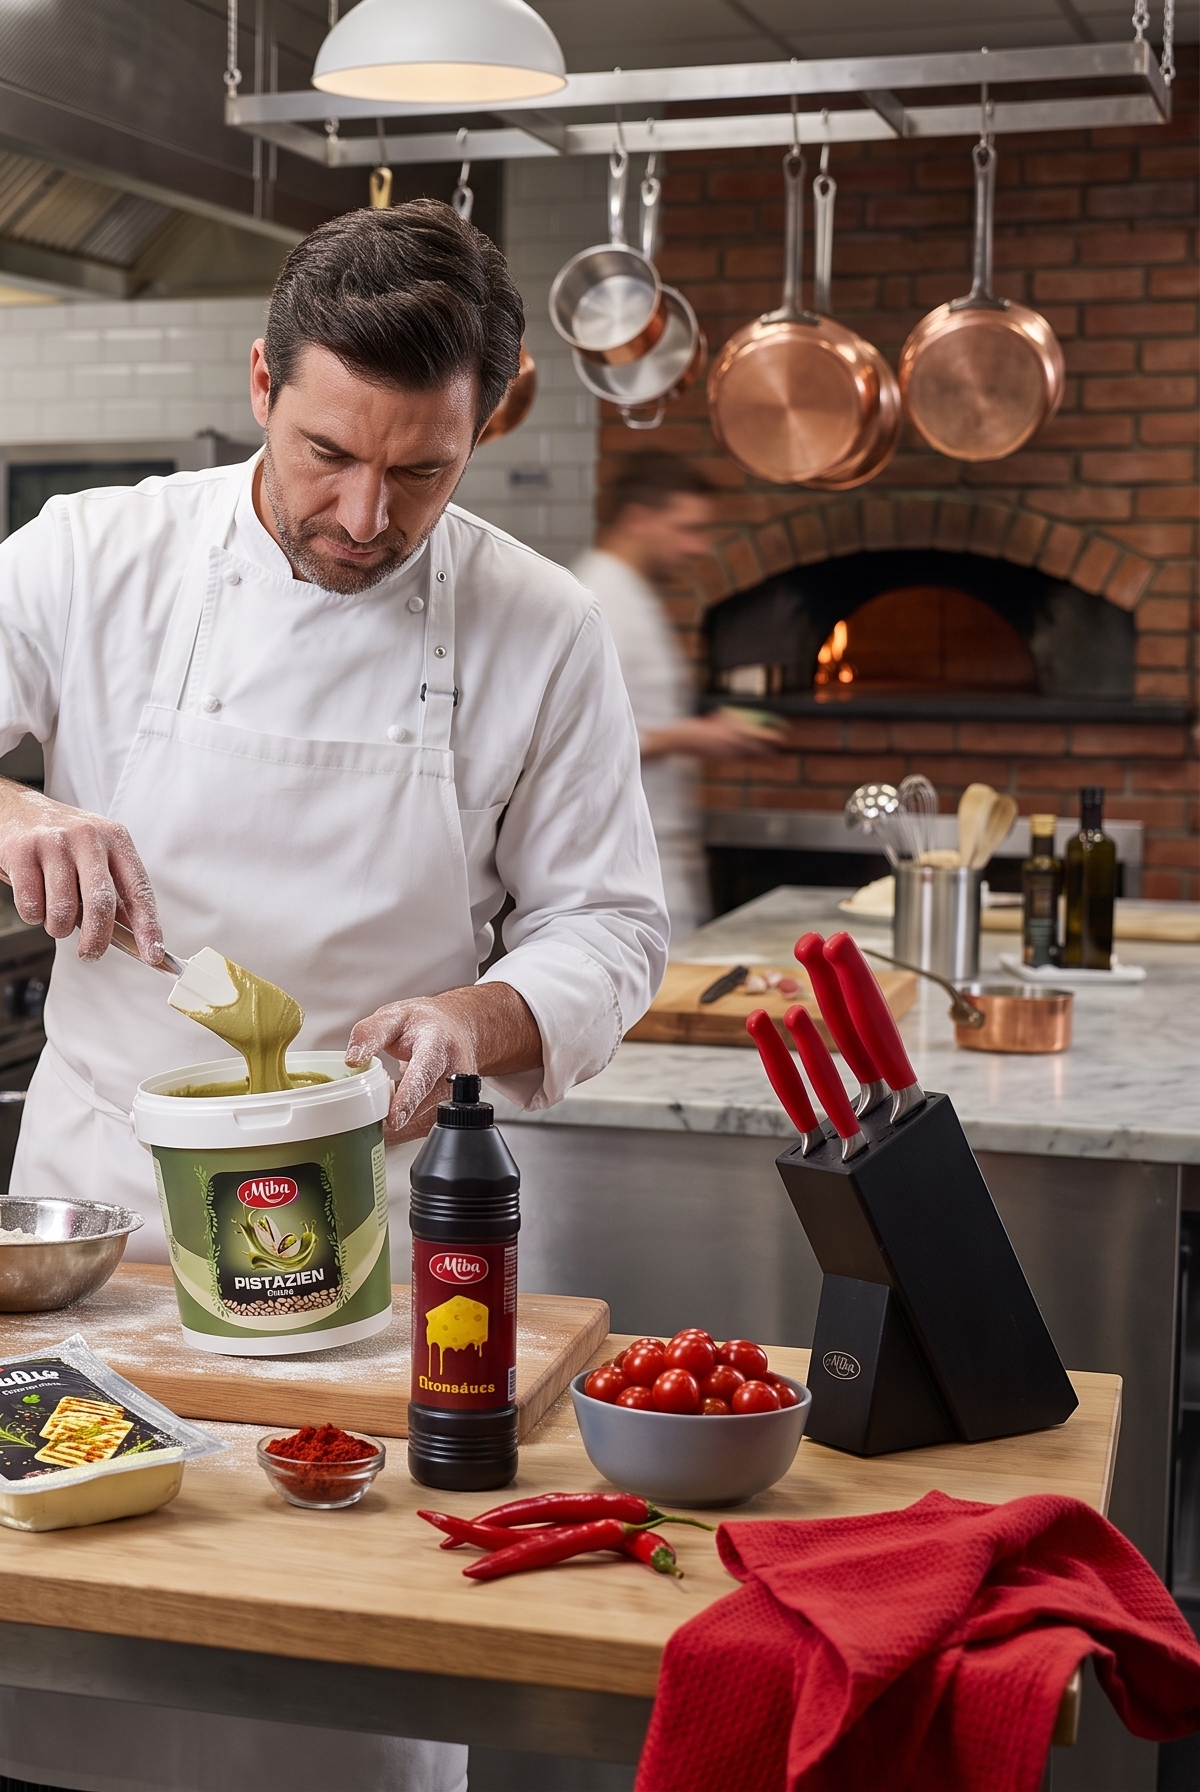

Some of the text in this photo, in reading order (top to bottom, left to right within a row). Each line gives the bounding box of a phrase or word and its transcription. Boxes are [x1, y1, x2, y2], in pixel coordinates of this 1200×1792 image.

[245, 1180, 291, 1204] Miba
[234, 1267, 325, 1290] PISTAZIEN
[436, 1256, 481, 1280] Miba
